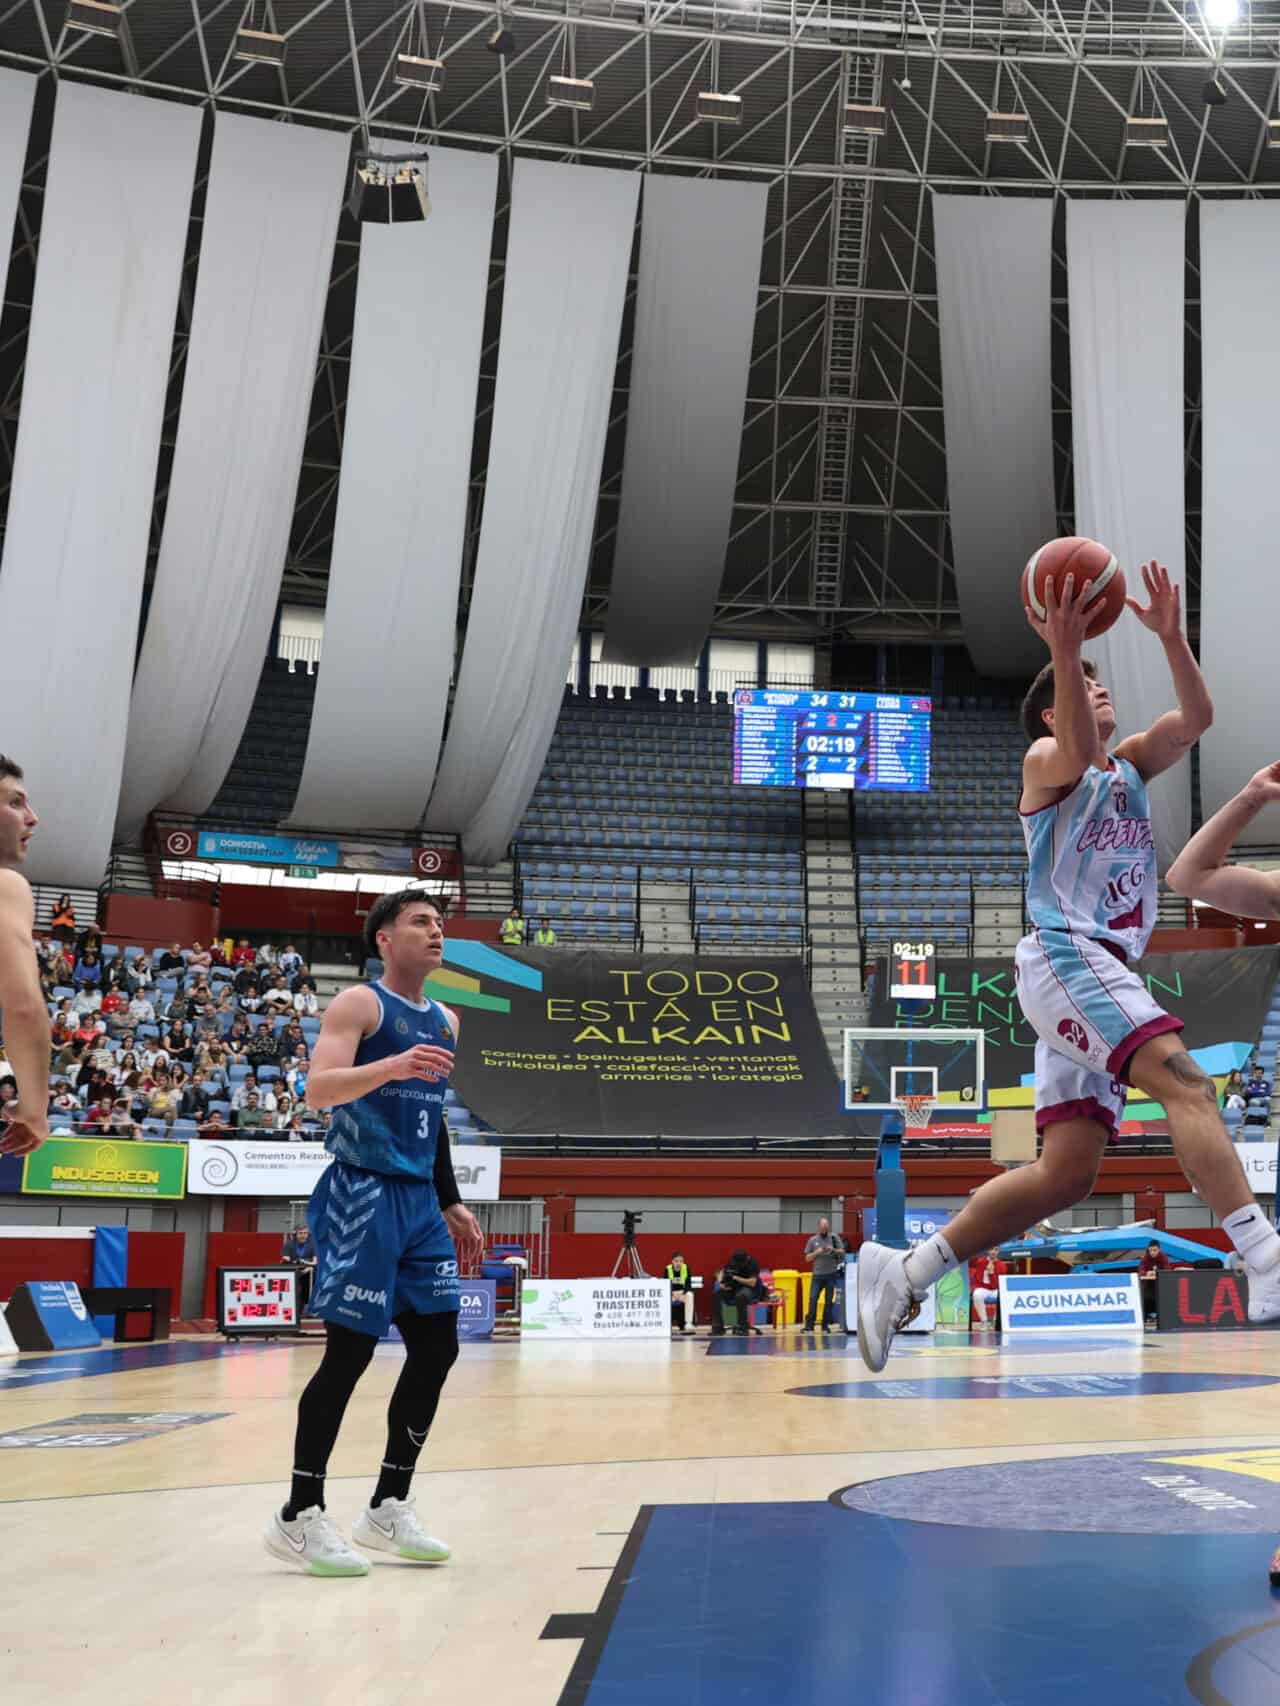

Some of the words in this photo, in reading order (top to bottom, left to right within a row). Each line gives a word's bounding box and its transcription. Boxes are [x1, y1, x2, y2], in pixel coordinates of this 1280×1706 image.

[810, 694, 828, 707] 34
[839, 695, 857, 707] 31
[827, 714, 837, 727] 2
[806, 736, 856, 753] 02:19
[807, 756, 818, 771] 2
[846, 757, 857, 772] 2
[893, 942, 934, 957] 02:19
[897, 961, 928, 985] 11
[608, 969, 779, 996] TODO
[546, 995, 691, 1022] ESTÁ
[711, 995, 785, 1021] EN
[572, 1021, 792, 1045] ALKAIN
[481, 1049, 557, 1060] cocinas
[576, 1052, 689, 1063] bainugelak
[704, 1053, 798, 1062] ventanas
[484, 1057, 587, 1072] brikolajea
[741, 1063, 800, 1072] lurrak
[599, 1072, 693, 1081] armarios
[416, 1109, 430, 1139] 3
[244, 1151, 297, 1161] Cementos
[592, 1289, 647, 1299] ALQUILER
[649, 1288, 664, 1298] DE
[1013, 1291, 1129, 1310] AGUINAMAR
[596, 1300, 660, 1311] TRASTEROS
